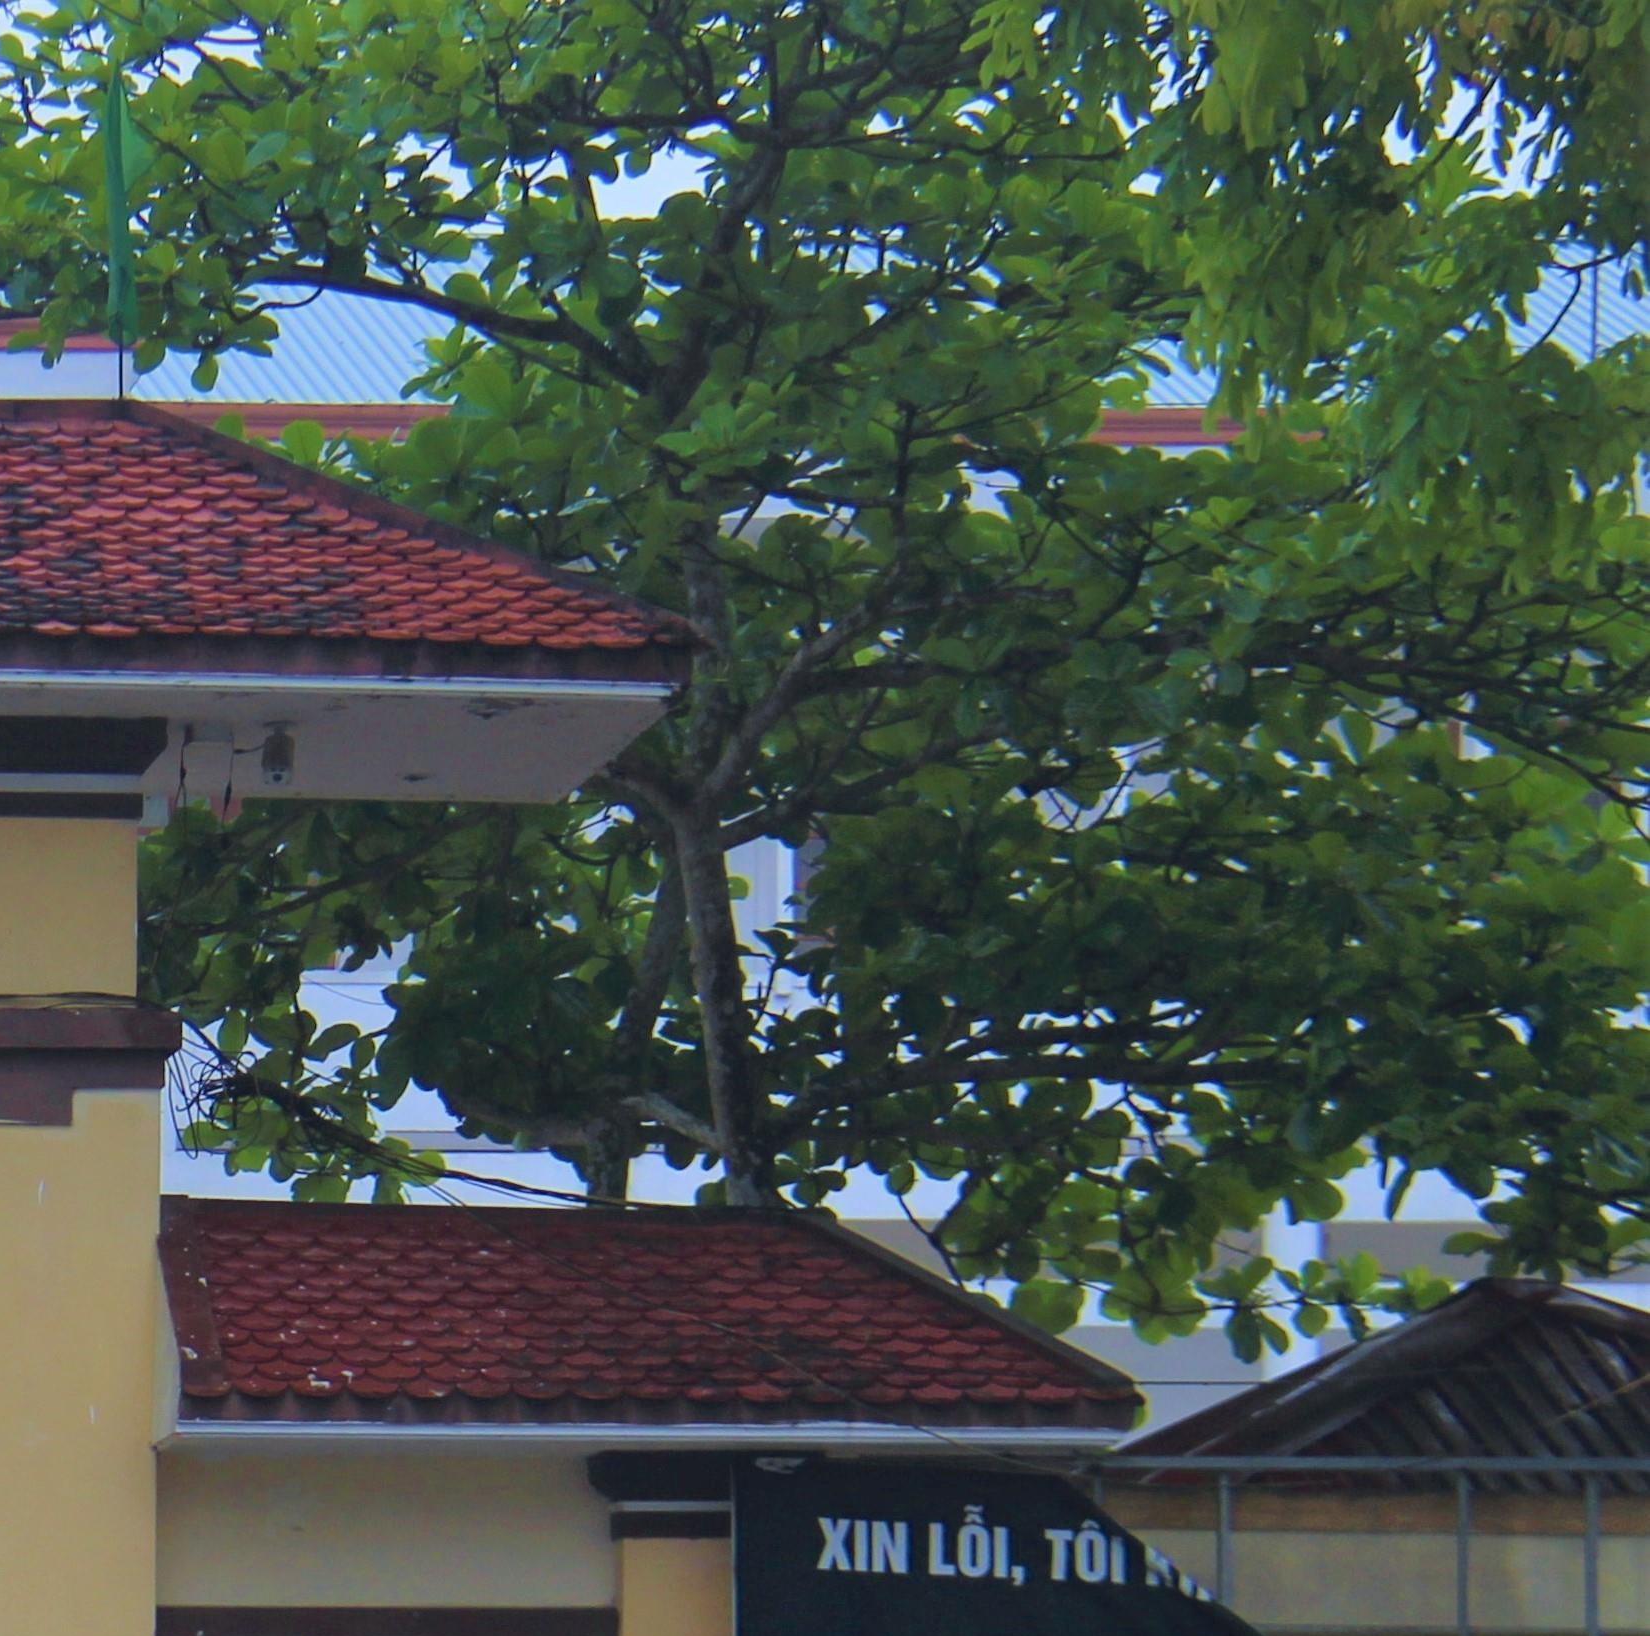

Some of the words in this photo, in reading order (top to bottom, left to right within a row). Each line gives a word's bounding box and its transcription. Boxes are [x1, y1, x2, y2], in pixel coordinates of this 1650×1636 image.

[817, 1517, 908, 1574] XIN
[928, 1505, 1026, 1586] LỖI,
[1045, 1519, 1125, 1584] TÔI
